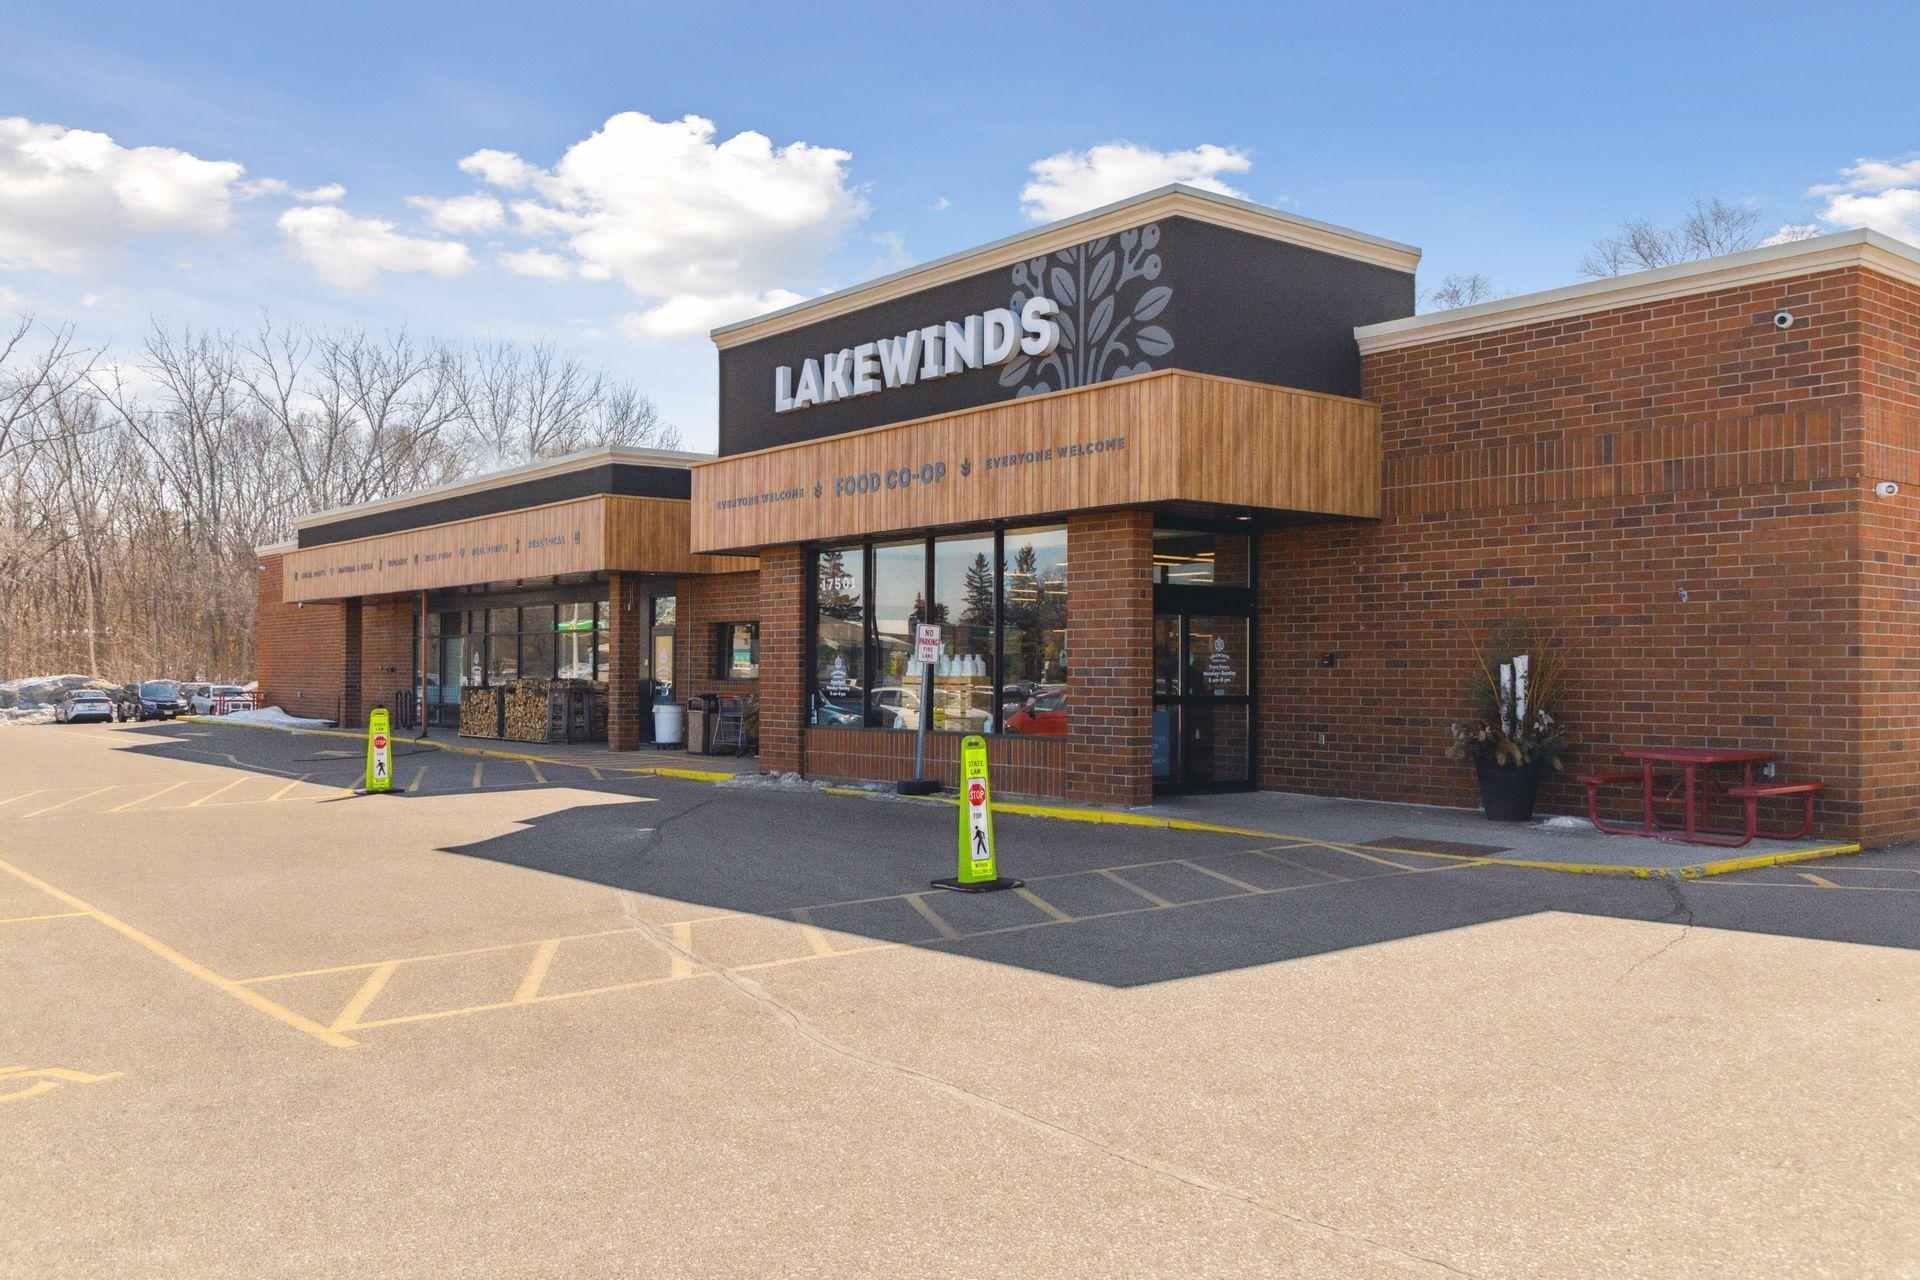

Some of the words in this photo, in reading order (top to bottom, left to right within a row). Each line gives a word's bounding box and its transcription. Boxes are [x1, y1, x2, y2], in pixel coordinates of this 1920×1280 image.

[775, 296, 1060, 413] LAKEWINDS
[715, 495, 759, 510] EVERYONE
[761, 488, 804, 505] WELCOME
[836, 472, 881, 497] FOOD
[885, 461, 946, 489] CO-OP
[985, 449, 1053, 470] EVERYONE
[1057, 437, 1126, 460] WELCOME
[925, 629, 934, 637] NO
[919, 638, 940, 646] PARKING
[968, 760, 984, 768] STATE
[969, 790, 986, 800] STOP
